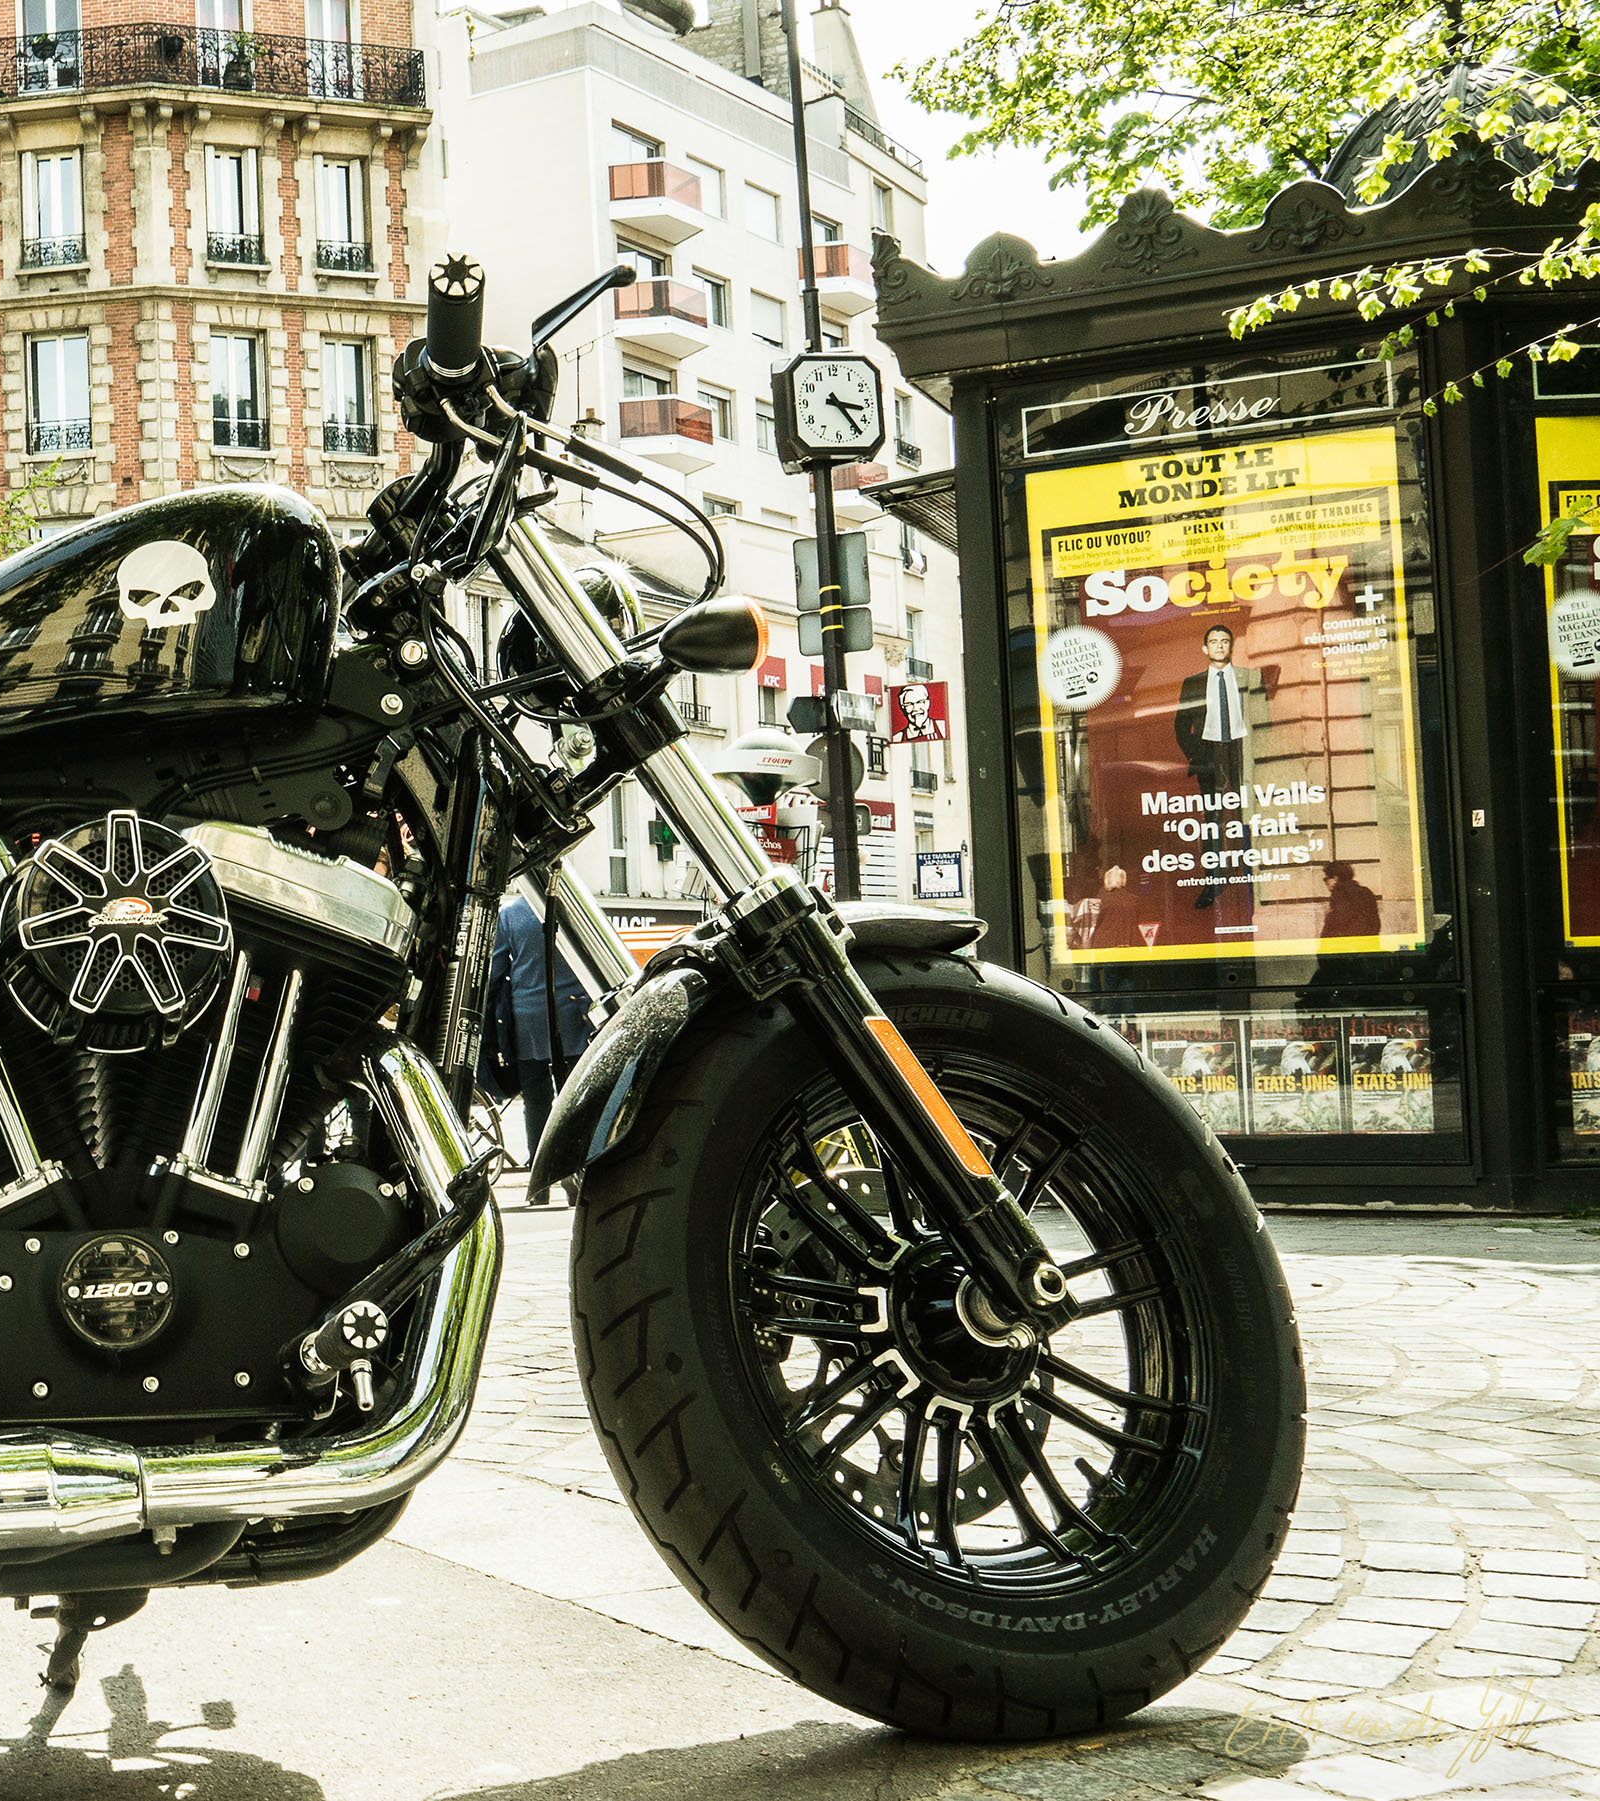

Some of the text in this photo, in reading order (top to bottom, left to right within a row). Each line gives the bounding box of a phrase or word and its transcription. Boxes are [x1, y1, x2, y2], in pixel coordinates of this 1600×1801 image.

[814, 372, 823, 382] 11
[828, 367, 838, 377] 12
[847, 372, 851, 382] 1
[804, 383, 815, 393] 10
[857, 383, 864, 393] 2
[802, 399, 809, 409] 9
[863, 399, 870, 409] 3
[808, 415, 815, 425] 8
[860, 414, 868, 424] 4
[1124, 393, 1280, 435] Presse
[820, 425, 827, 436] 7
[835, 430, 843, 441] 6
[1140, 447, 1274, 482] TOUT LE
[1118, 468, 1300, 509] MONDE LIT
[1270, 503, 1373, 524] GAME OF THRONES
[1183, 518, 1239, 536] PRINCE
[1058, 530, 1152, 553] FLIC OU VOYOU?
[1085, 551, 1349, 617] Society
[1322, 613, 1387, 630] comment
[1558, 608, 1600, 622] MEILLEU
[1304, 627, 1387, 645] réinventer la
[1559, 629, 1600, 643] DE L'ANN
[1051, 642, 1098, 660] MEILLEUR
[1322, 639, 1388, 658] politique?
[1051, 650, 1102, 670] MAGAZINE
[764, 674, 781, 687] KFC
[1052, 668, 1065, 679] DE
[1141, 781, 1326, 816] Manuel Valls
[1163, 812, 1300, 842] “On a fait
[1142, 839, 1324, 873] des erreurs”
[1177, 875, 1227, 888] entretien
[1229, 873, 1272, 884] exclusif
[606, 915, 657, 928] MACIE
[1152, 1024, 1235, 1042] Historia
[1251, 1020, 1336, 1041] Historia
[1170, 1074, 1237, 1094] ATS-UNIS
[1254, 1073, 1337, 1093] ÉTATS-UNIS
[83, 1281, 153, 1299] 1200
[887, 1523, 1218, 1634] HARLEY-DAVIDSON
